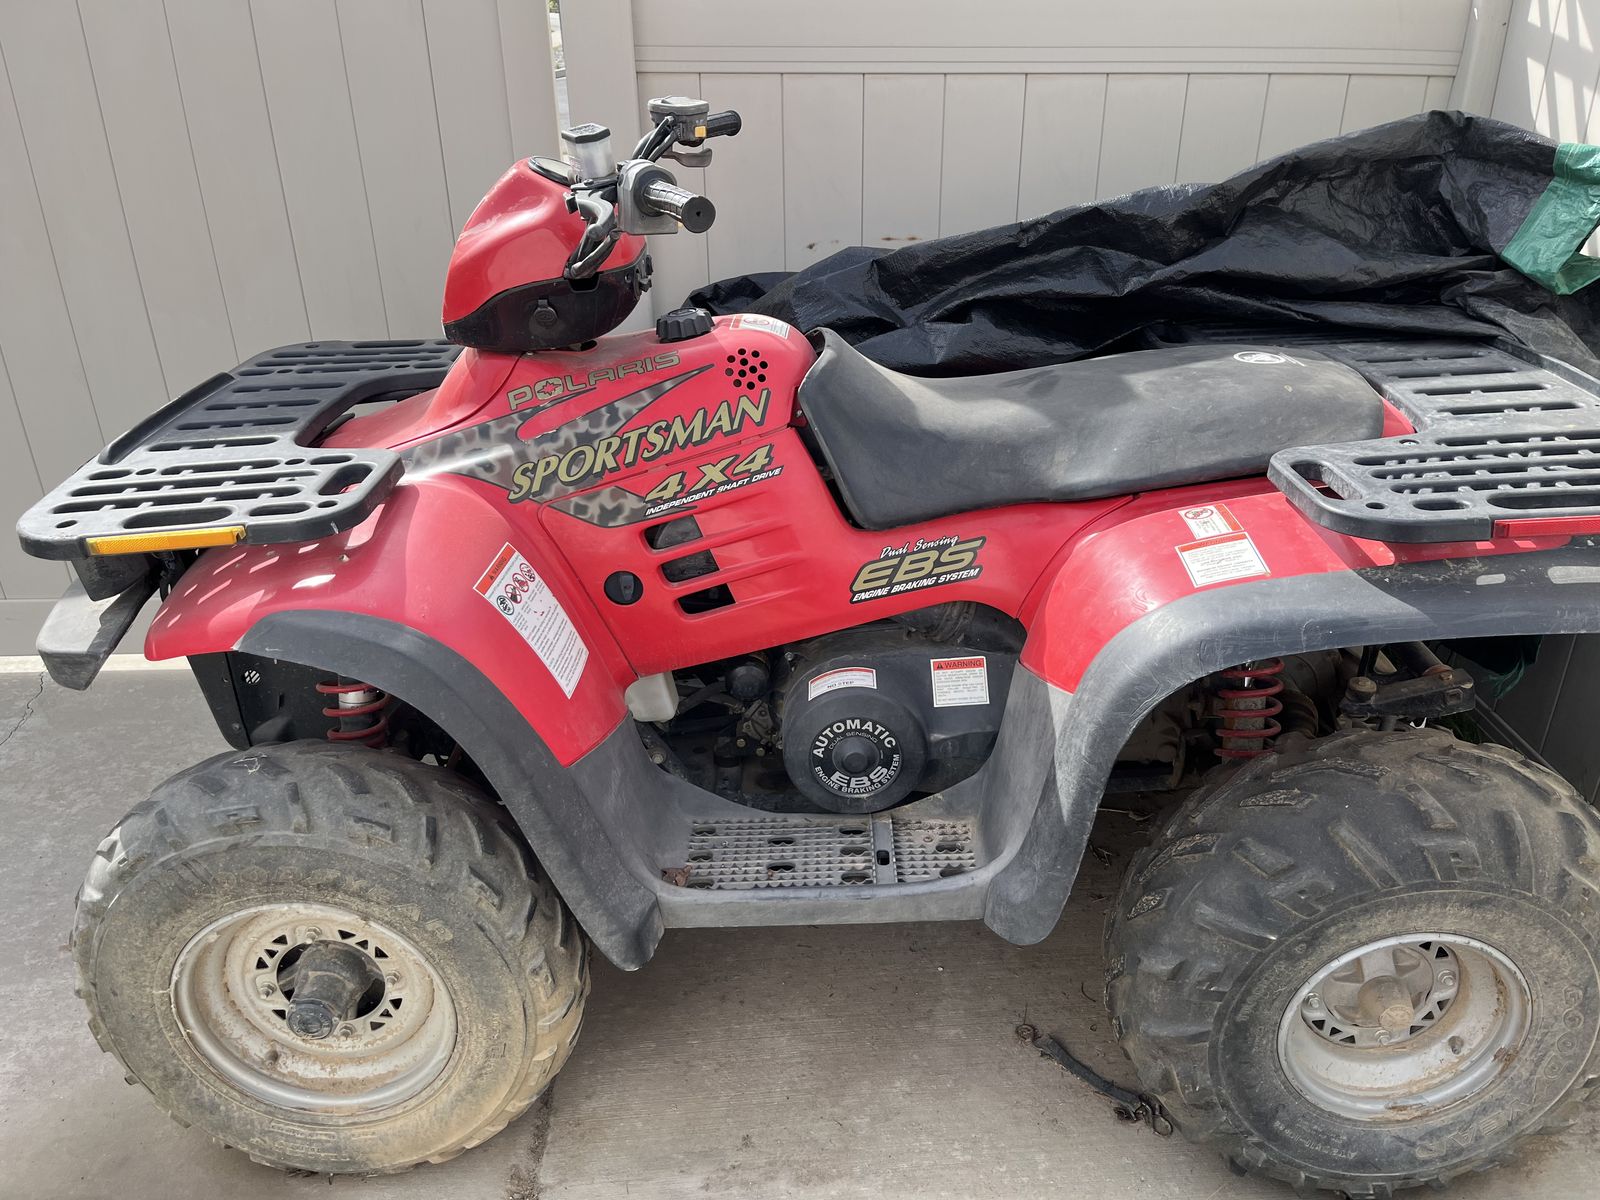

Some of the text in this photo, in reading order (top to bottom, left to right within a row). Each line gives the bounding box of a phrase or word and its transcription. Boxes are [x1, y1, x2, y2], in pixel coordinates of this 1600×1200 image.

[507, 350, 681, 410] POLARIS
[508, 388, 770, 502] SPORTSMAN
[645, 467, 782, 516] INDEPENDENT SHAFT DRIVE
[853, 539, 983, 592] EBS
[880, 535, 959, 559] Dual Sensing
[852, 568, 980, 602] ENGINE BRAKING SYSTEM
[944, 660, 982, 669] WARNING
[813, 719, 896, 758] AUTOMATIC
[828, 731, 879, 750] DUAL SENSING
[814, 754, 900, 794] ENGINE BRAKING SYSTEM
[830, 766, 888, 788] EBS
